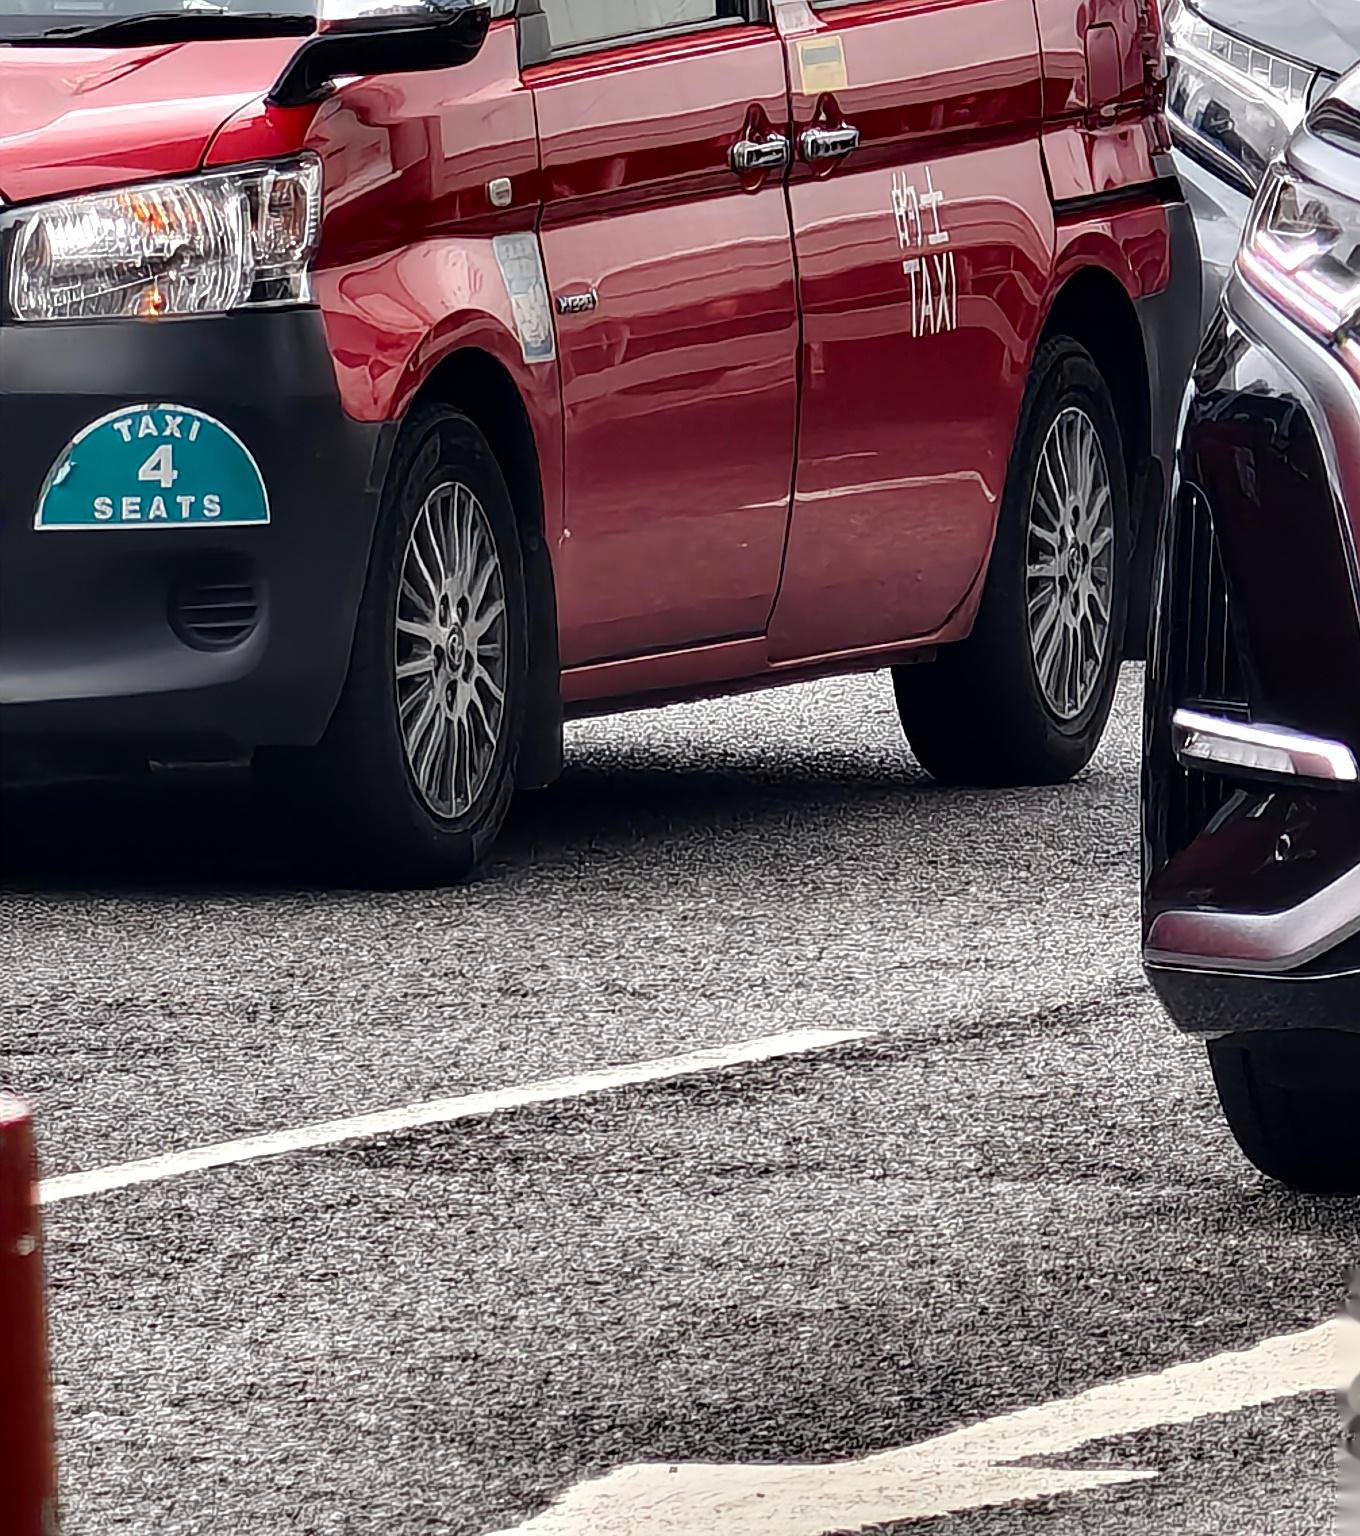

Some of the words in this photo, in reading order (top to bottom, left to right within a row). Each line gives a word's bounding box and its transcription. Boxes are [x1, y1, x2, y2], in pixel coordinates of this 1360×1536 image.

[902, 251, 957, 338] TAXI
[113, 414, 201, 443] TAXI
[137, 443, 178, 489] 4
[93, 494, 221, 520] SEATS
